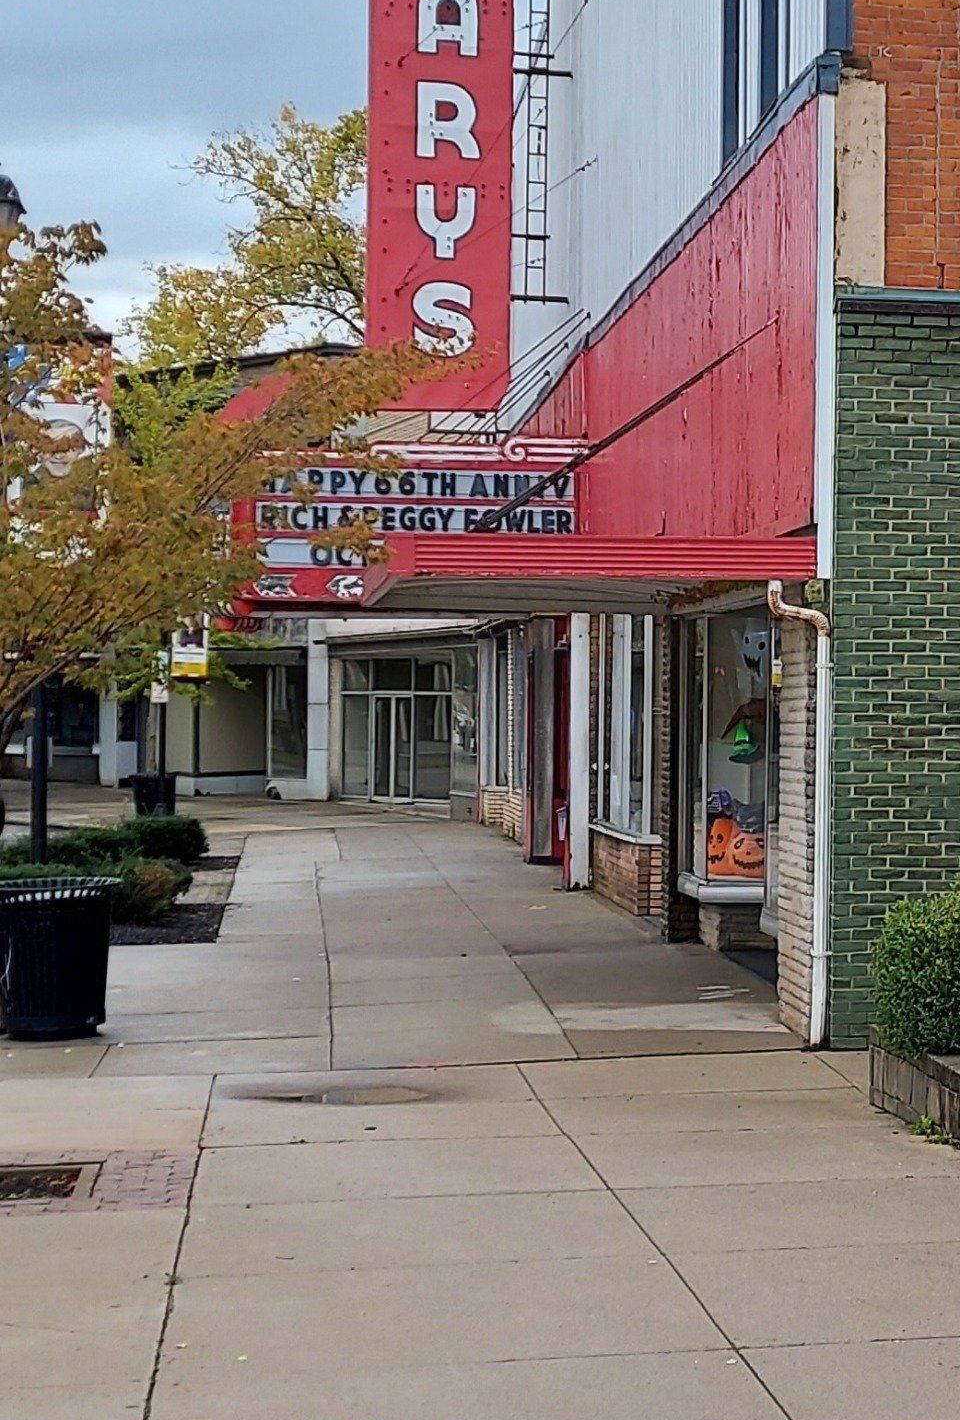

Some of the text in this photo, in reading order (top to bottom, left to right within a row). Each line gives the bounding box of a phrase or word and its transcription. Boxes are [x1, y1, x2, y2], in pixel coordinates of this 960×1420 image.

[374, 470, 456, 496] 66TH
[261, 505, 328, 530] RICH
[464, 508, 573, 534] FOWLER
